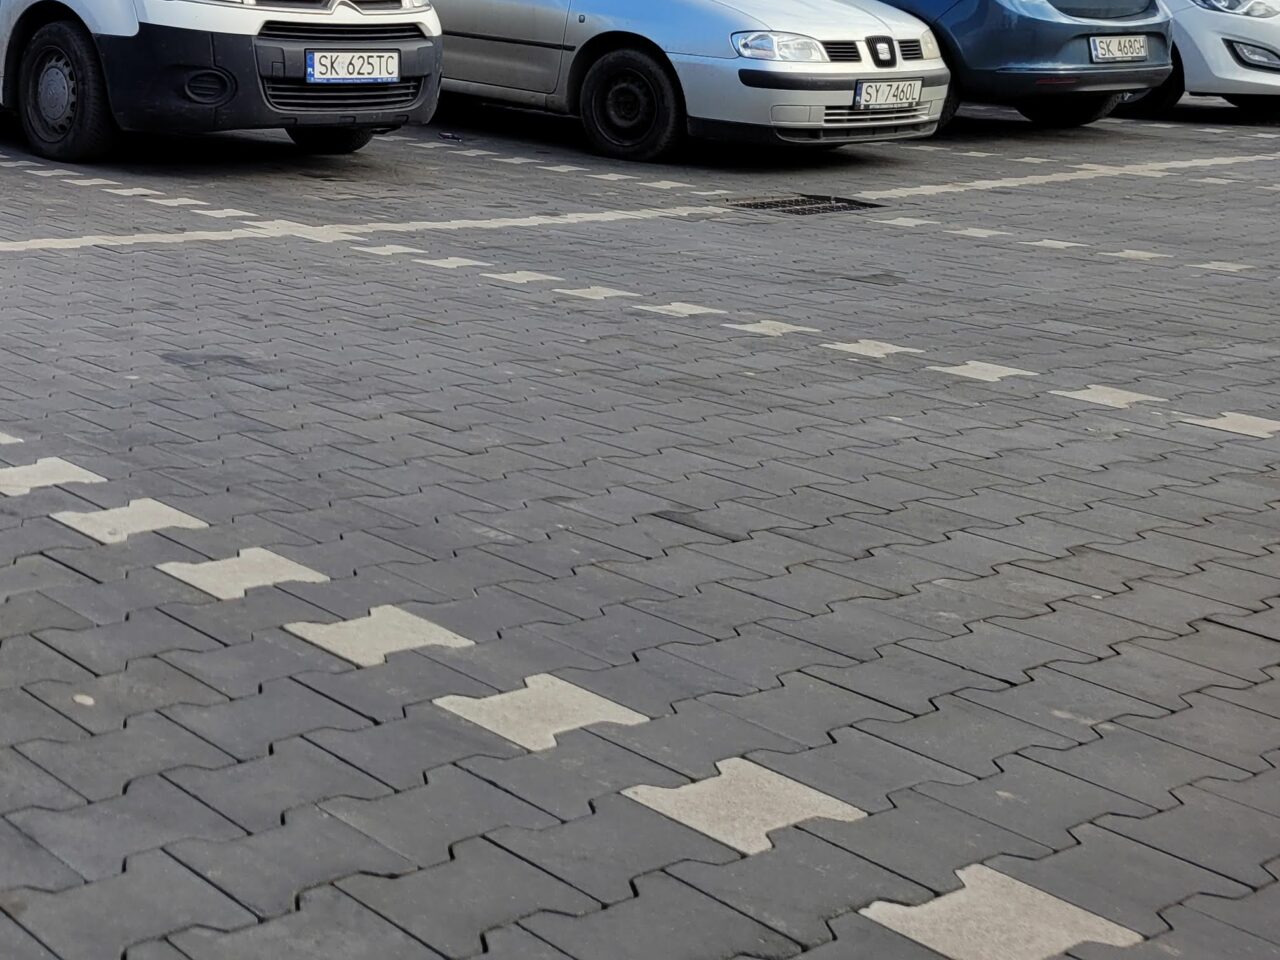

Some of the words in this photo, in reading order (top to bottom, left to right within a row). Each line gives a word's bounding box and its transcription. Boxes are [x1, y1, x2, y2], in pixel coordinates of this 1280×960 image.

[1099, 39, 1115, 57] SK
[1117, 38, 1145, 56] 468GH
[319, 55, 340, 76] SK
[346, 55, 394, 76] 625TC
[864, 84, 882, 103] SY
[885, 82, 917, 102] 7460L
